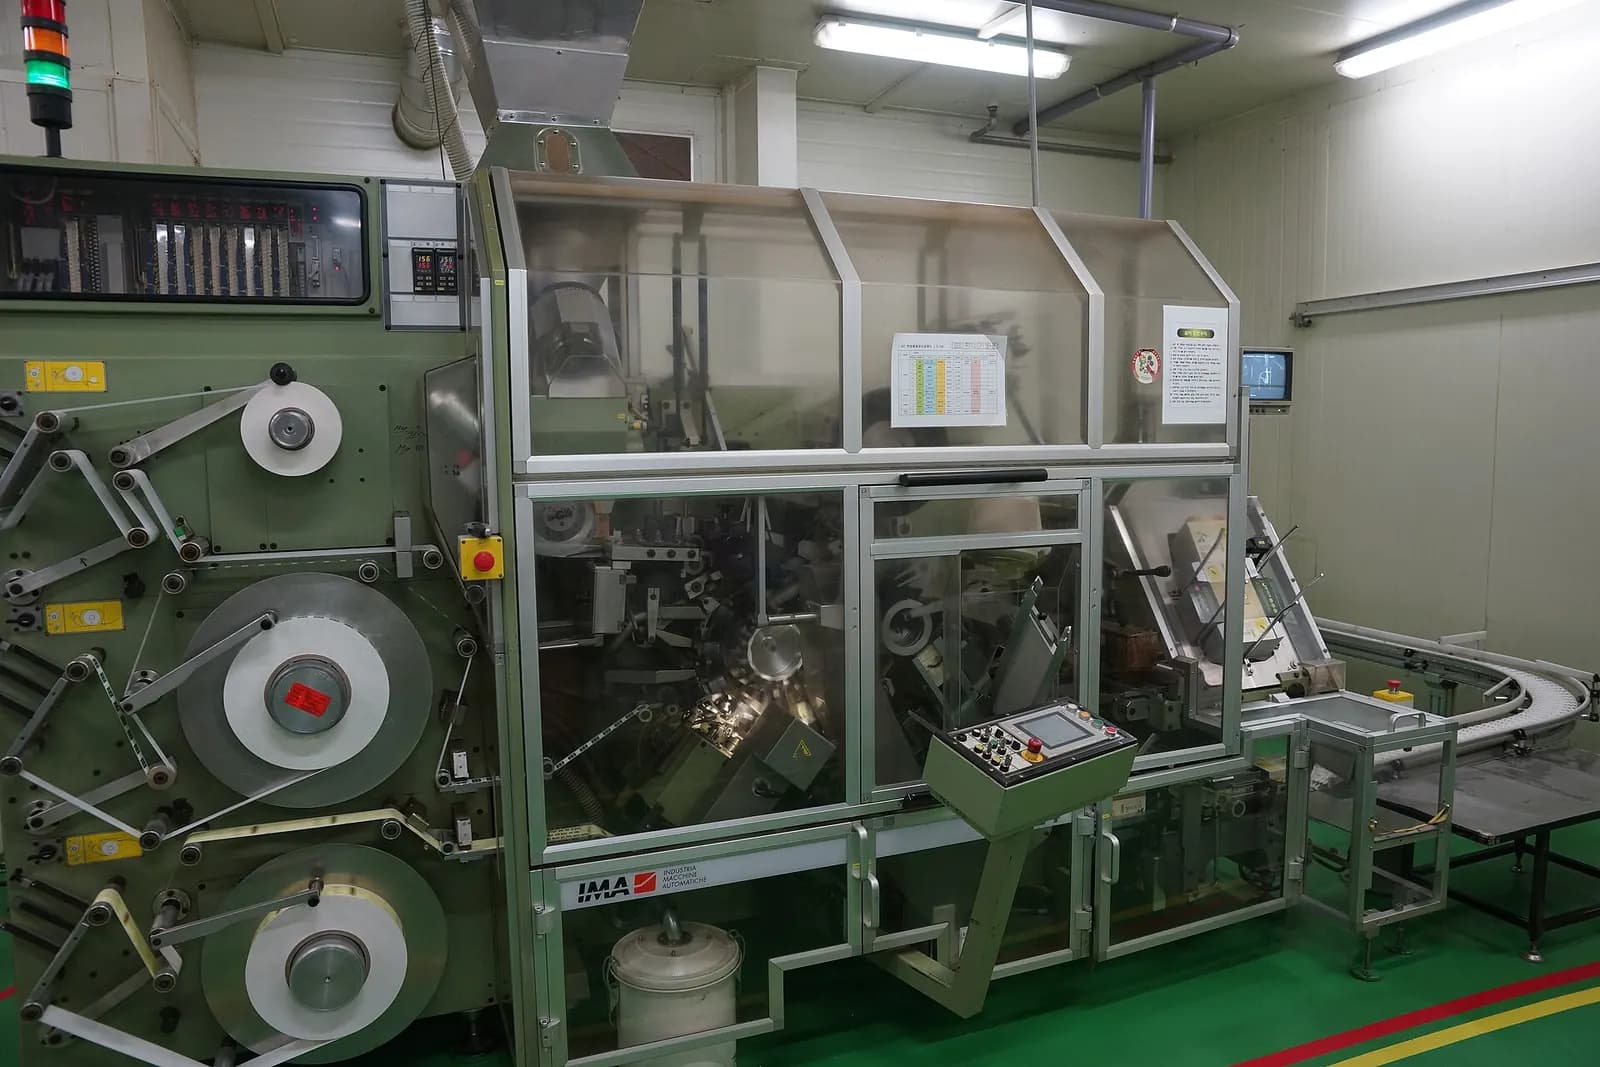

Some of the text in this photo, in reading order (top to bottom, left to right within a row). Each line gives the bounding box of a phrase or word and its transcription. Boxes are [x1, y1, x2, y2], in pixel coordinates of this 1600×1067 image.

[663, 866, 697, 876] INDUSTRIA
[662, 872, 697, 882] MACCHINE
[662, 878, 707, 889] AUTOMATICHE
[577, 876, 630, 903] IMA
